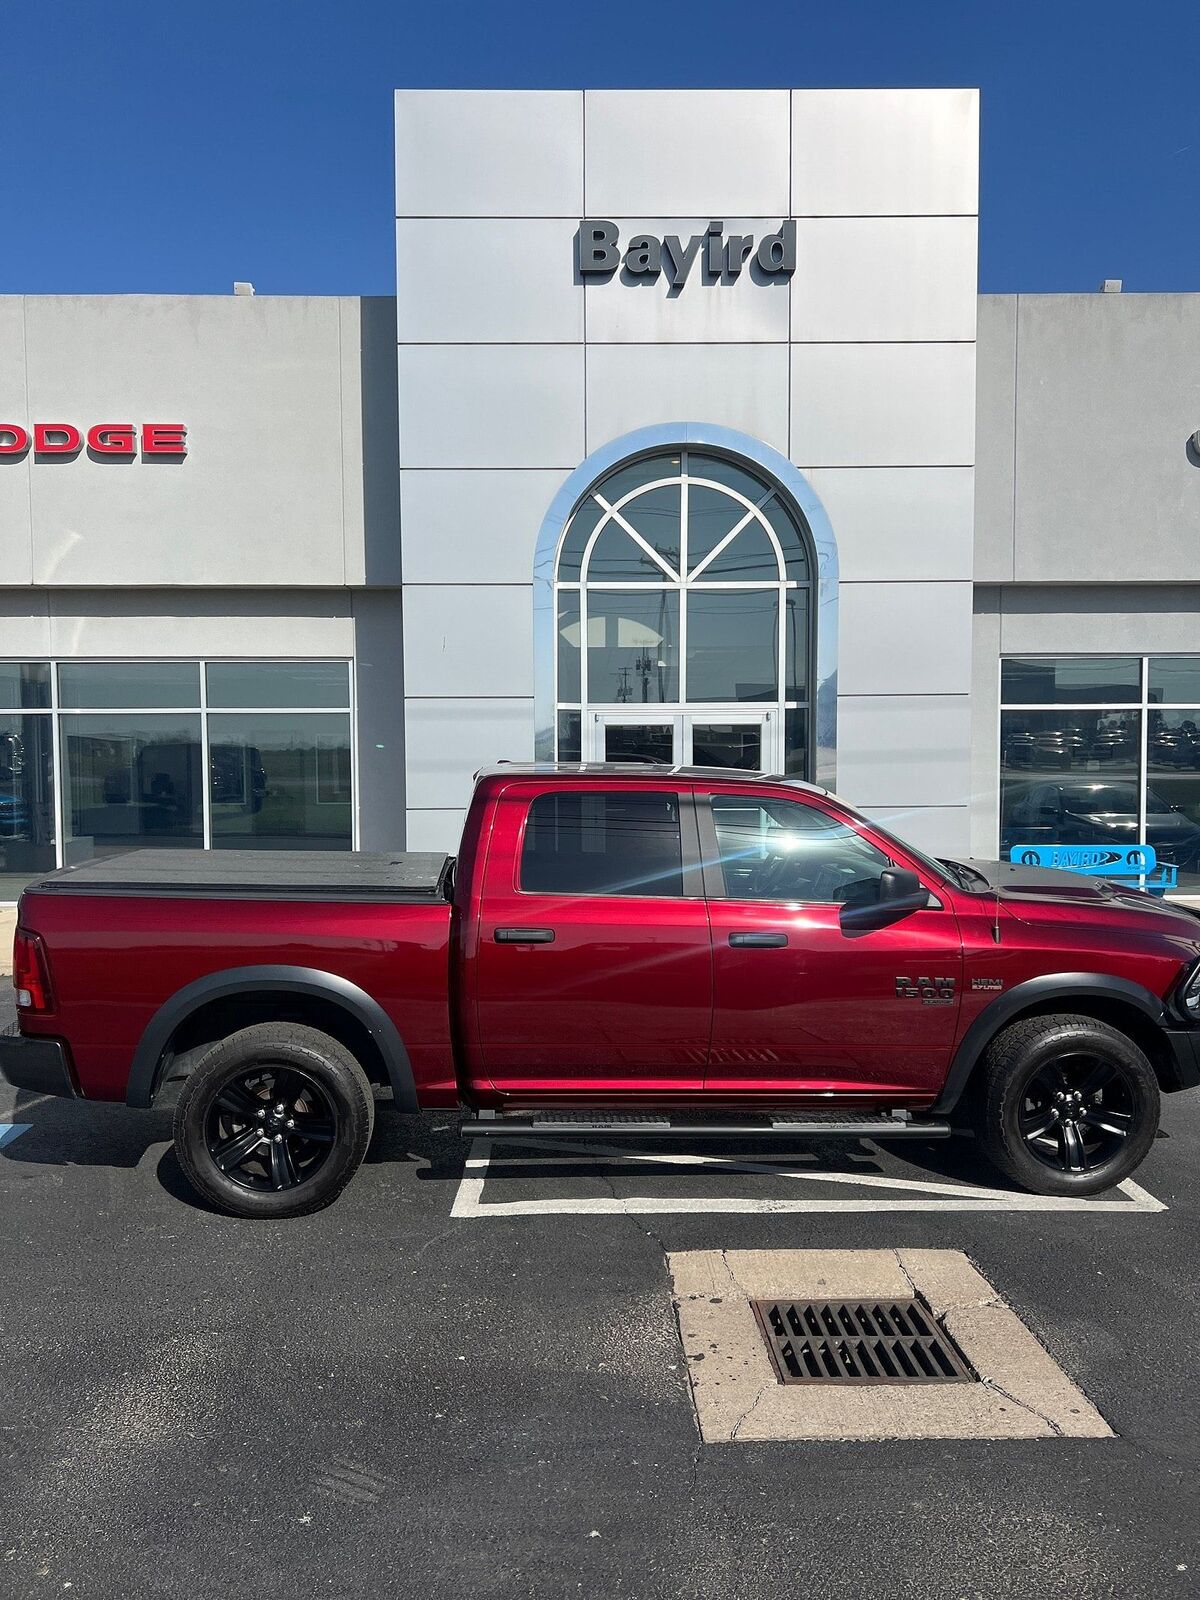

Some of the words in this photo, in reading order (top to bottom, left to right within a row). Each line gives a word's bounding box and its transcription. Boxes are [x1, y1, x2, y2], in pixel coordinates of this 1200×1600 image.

[579, 219, 797, 286] Bayird
[1052, 851, 1101, 866] BAYIRD
[895, 976, 956, 988] RAM
[895, 987, 955, 998] 1500
